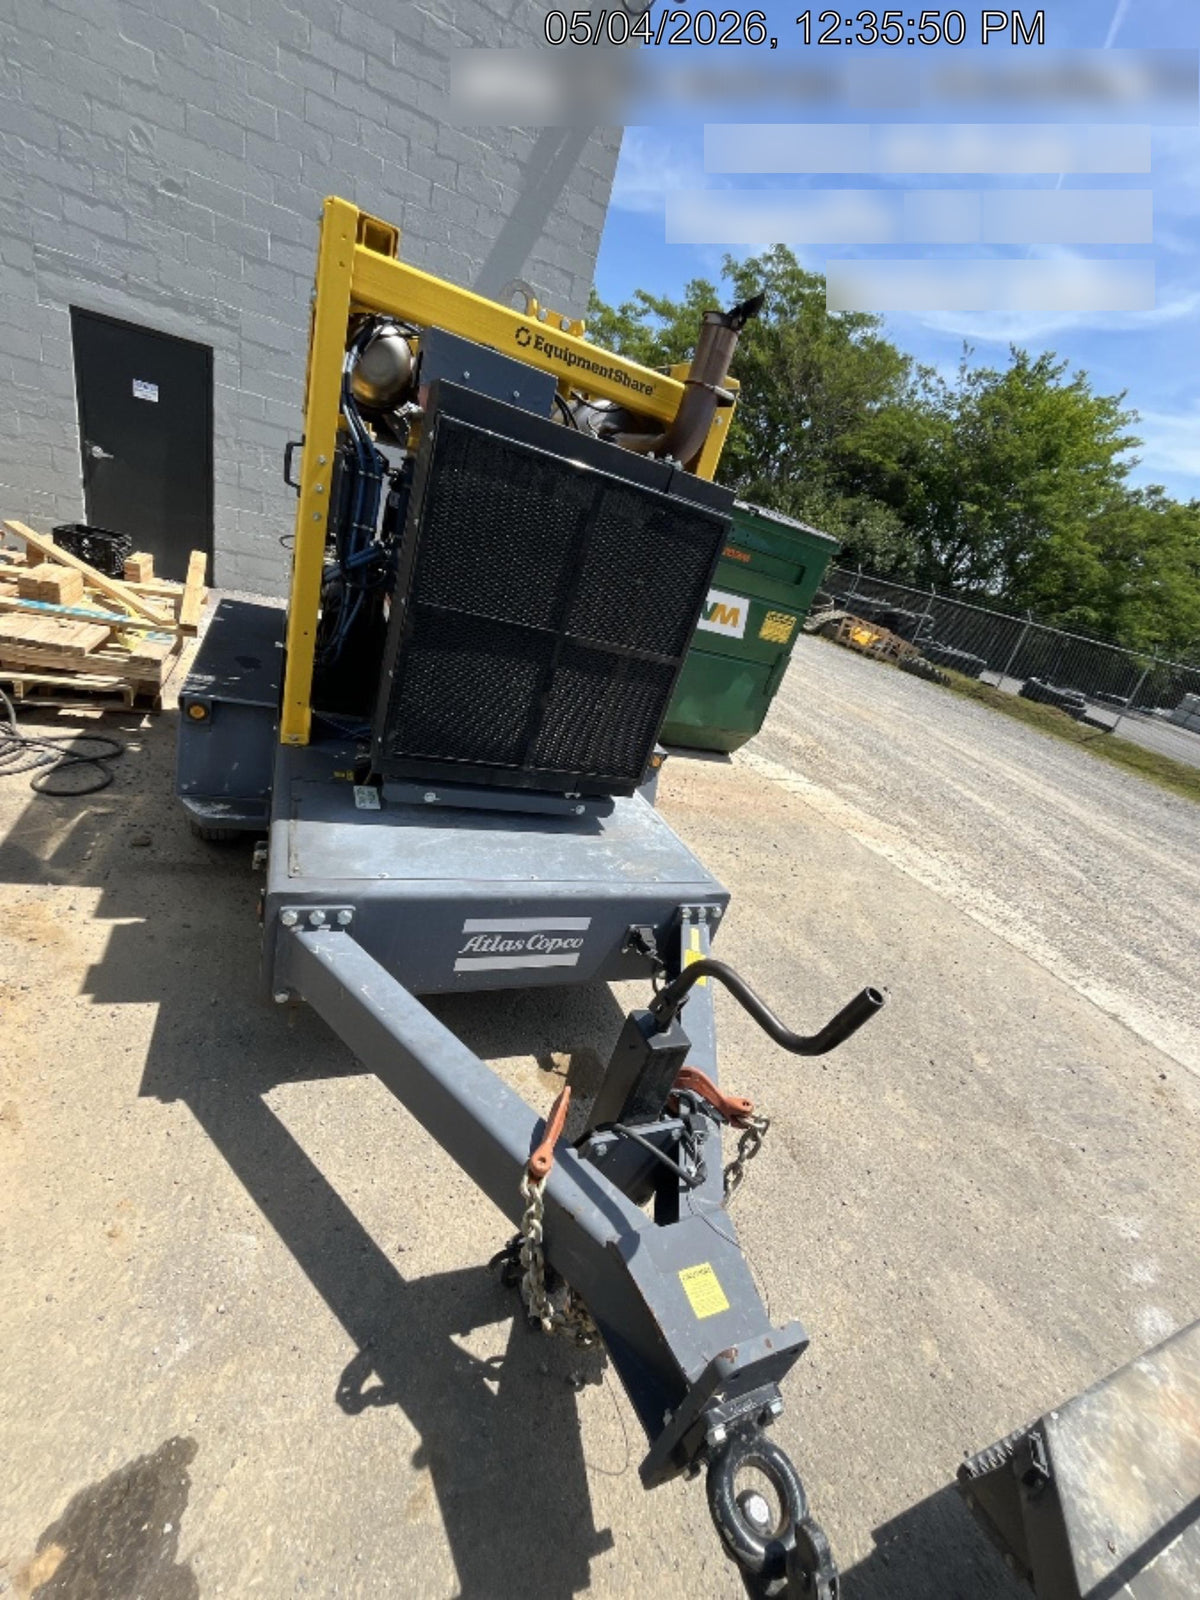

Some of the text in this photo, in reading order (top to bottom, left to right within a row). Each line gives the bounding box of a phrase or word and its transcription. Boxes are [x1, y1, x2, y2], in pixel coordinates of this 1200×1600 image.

[533, 335, 654, 396] EquipmentShare
[457, 933, 584, 954] Atlas Copco
